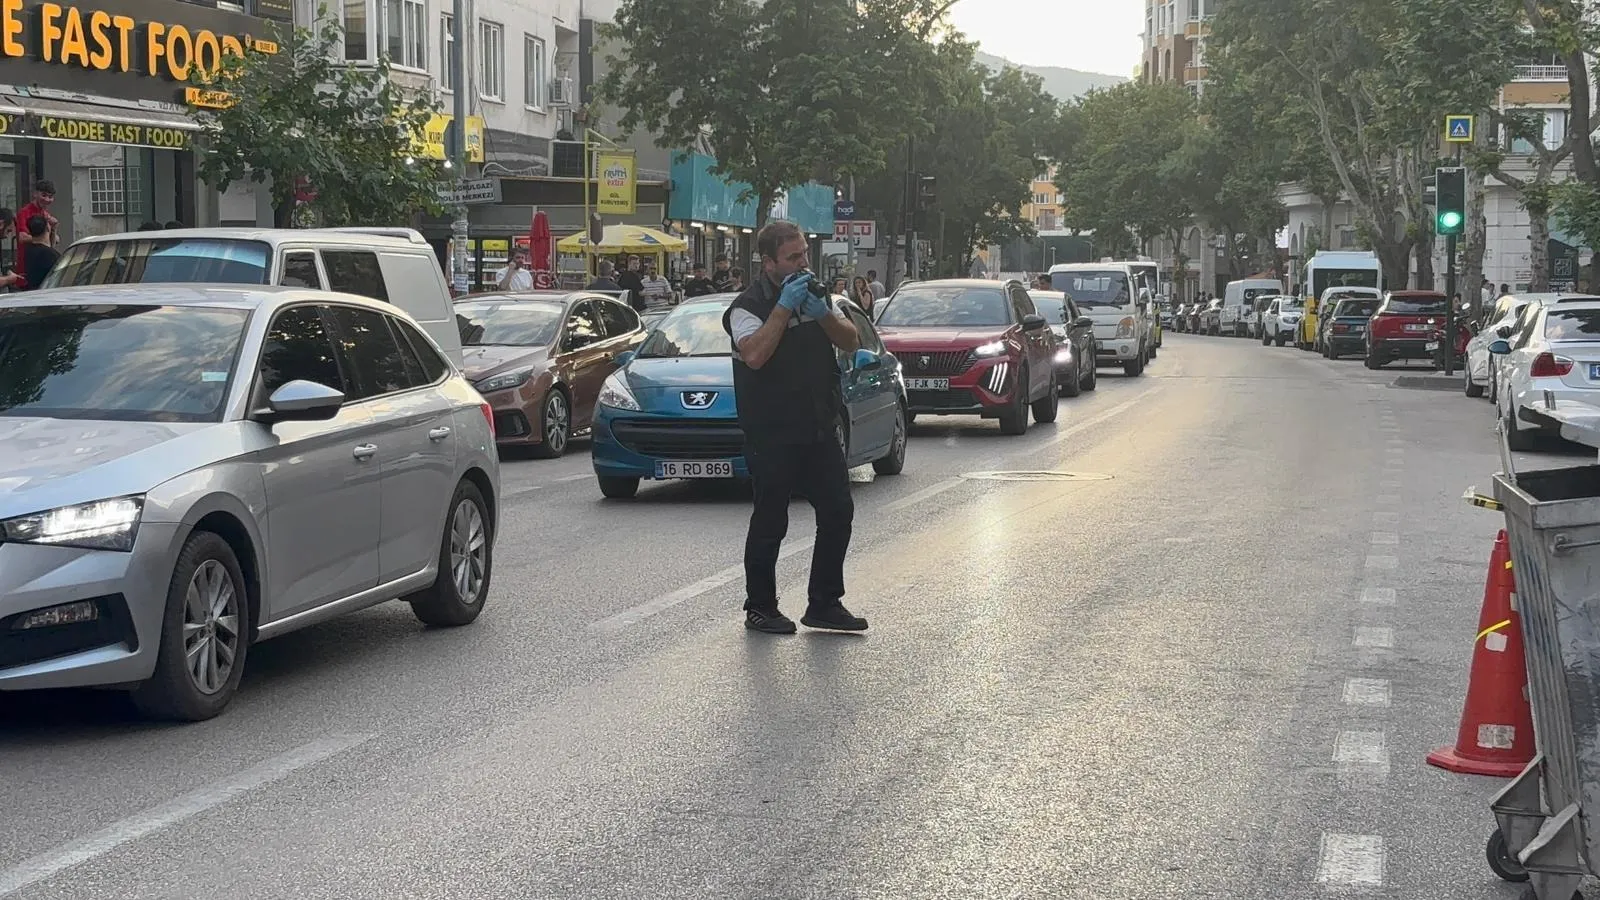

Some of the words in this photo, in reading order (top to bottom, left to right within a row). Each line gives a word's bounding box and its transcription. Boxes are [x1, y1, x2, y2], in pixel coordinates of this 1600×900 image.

[42, 2, 135, 73] FAST
[148, 21, 245, 85] FOOD
[110, 123, 142, 144] FAST
[146, 127, 184, 147] FOOD
[428, 131, 444, 144] KUR
[663, 463, 677, 475] 16
[682, 463, 702, 475] RD
[705, 463, 730, 475] 869
